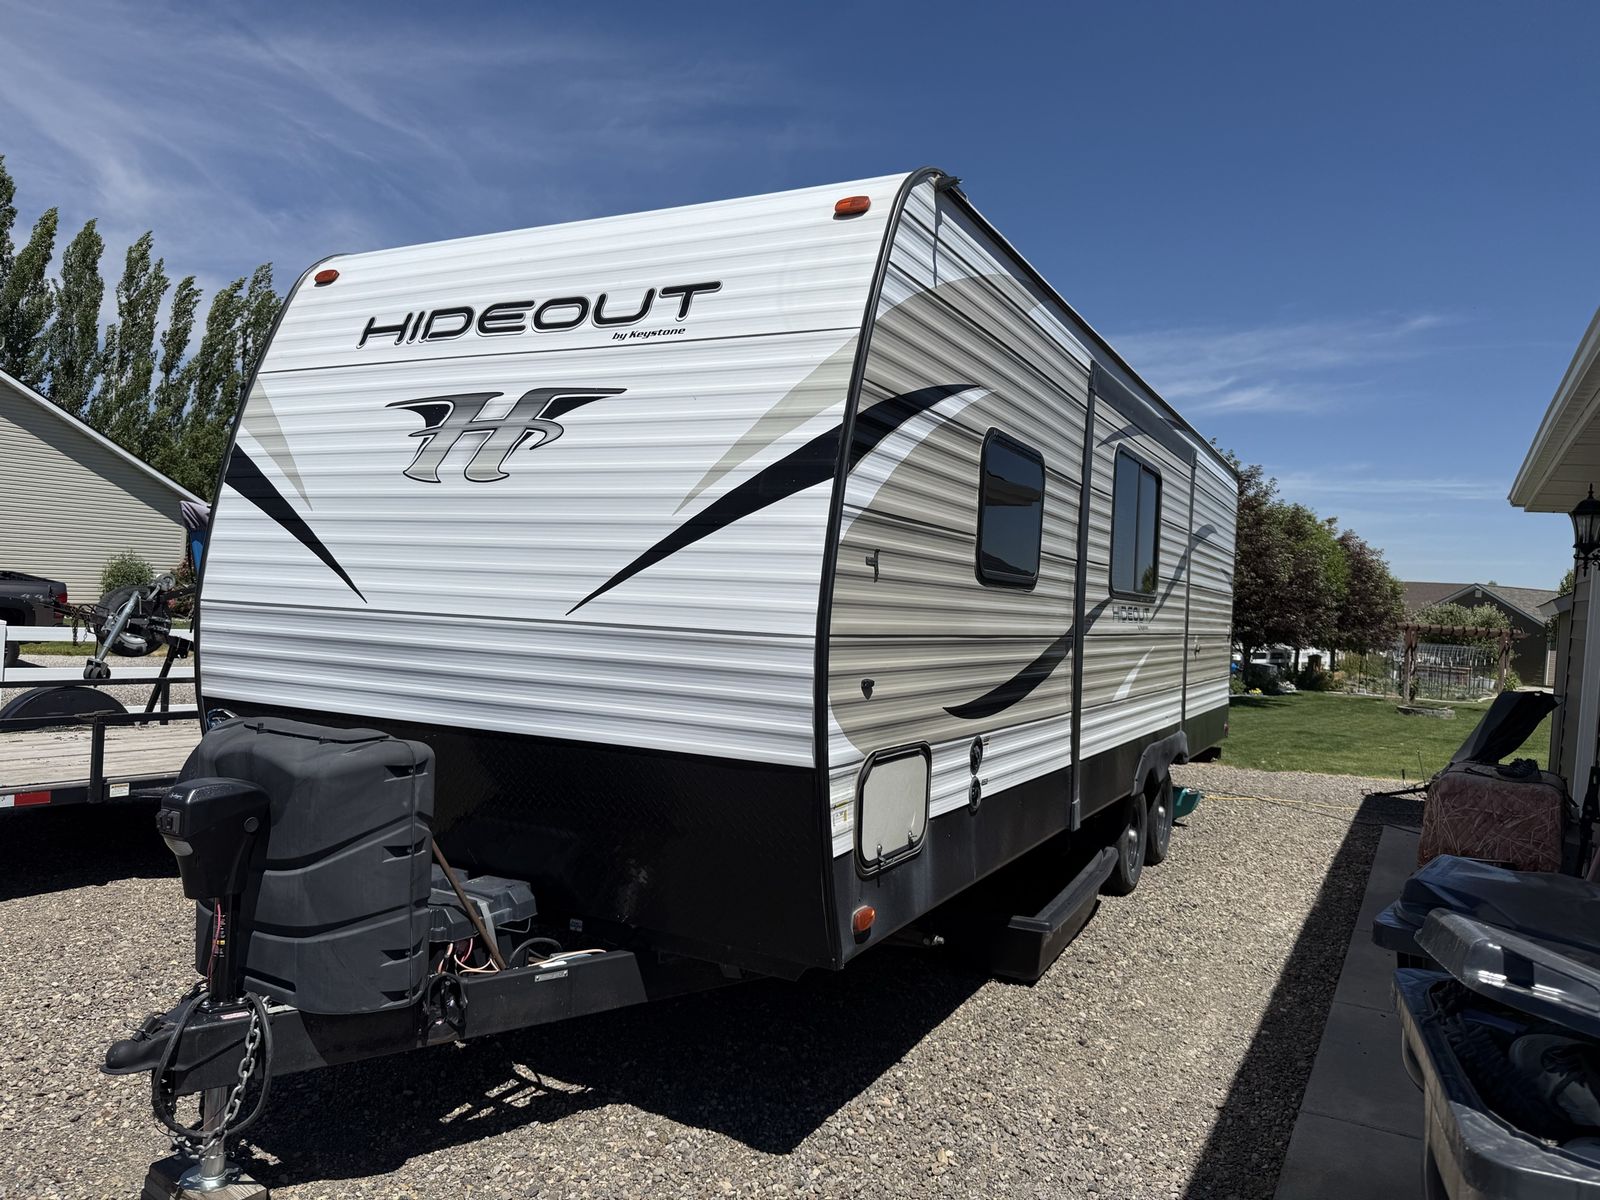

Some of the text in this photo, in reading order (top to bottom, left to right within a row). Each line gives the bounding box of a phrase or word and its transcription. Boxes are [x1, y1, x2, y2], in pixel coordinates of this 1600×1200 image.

[356, 280, 723, 350] HIDEOUT
[612, 328, 686, 341] by Keystone
[1112, 605, 1150, 622] HIDEOUT
